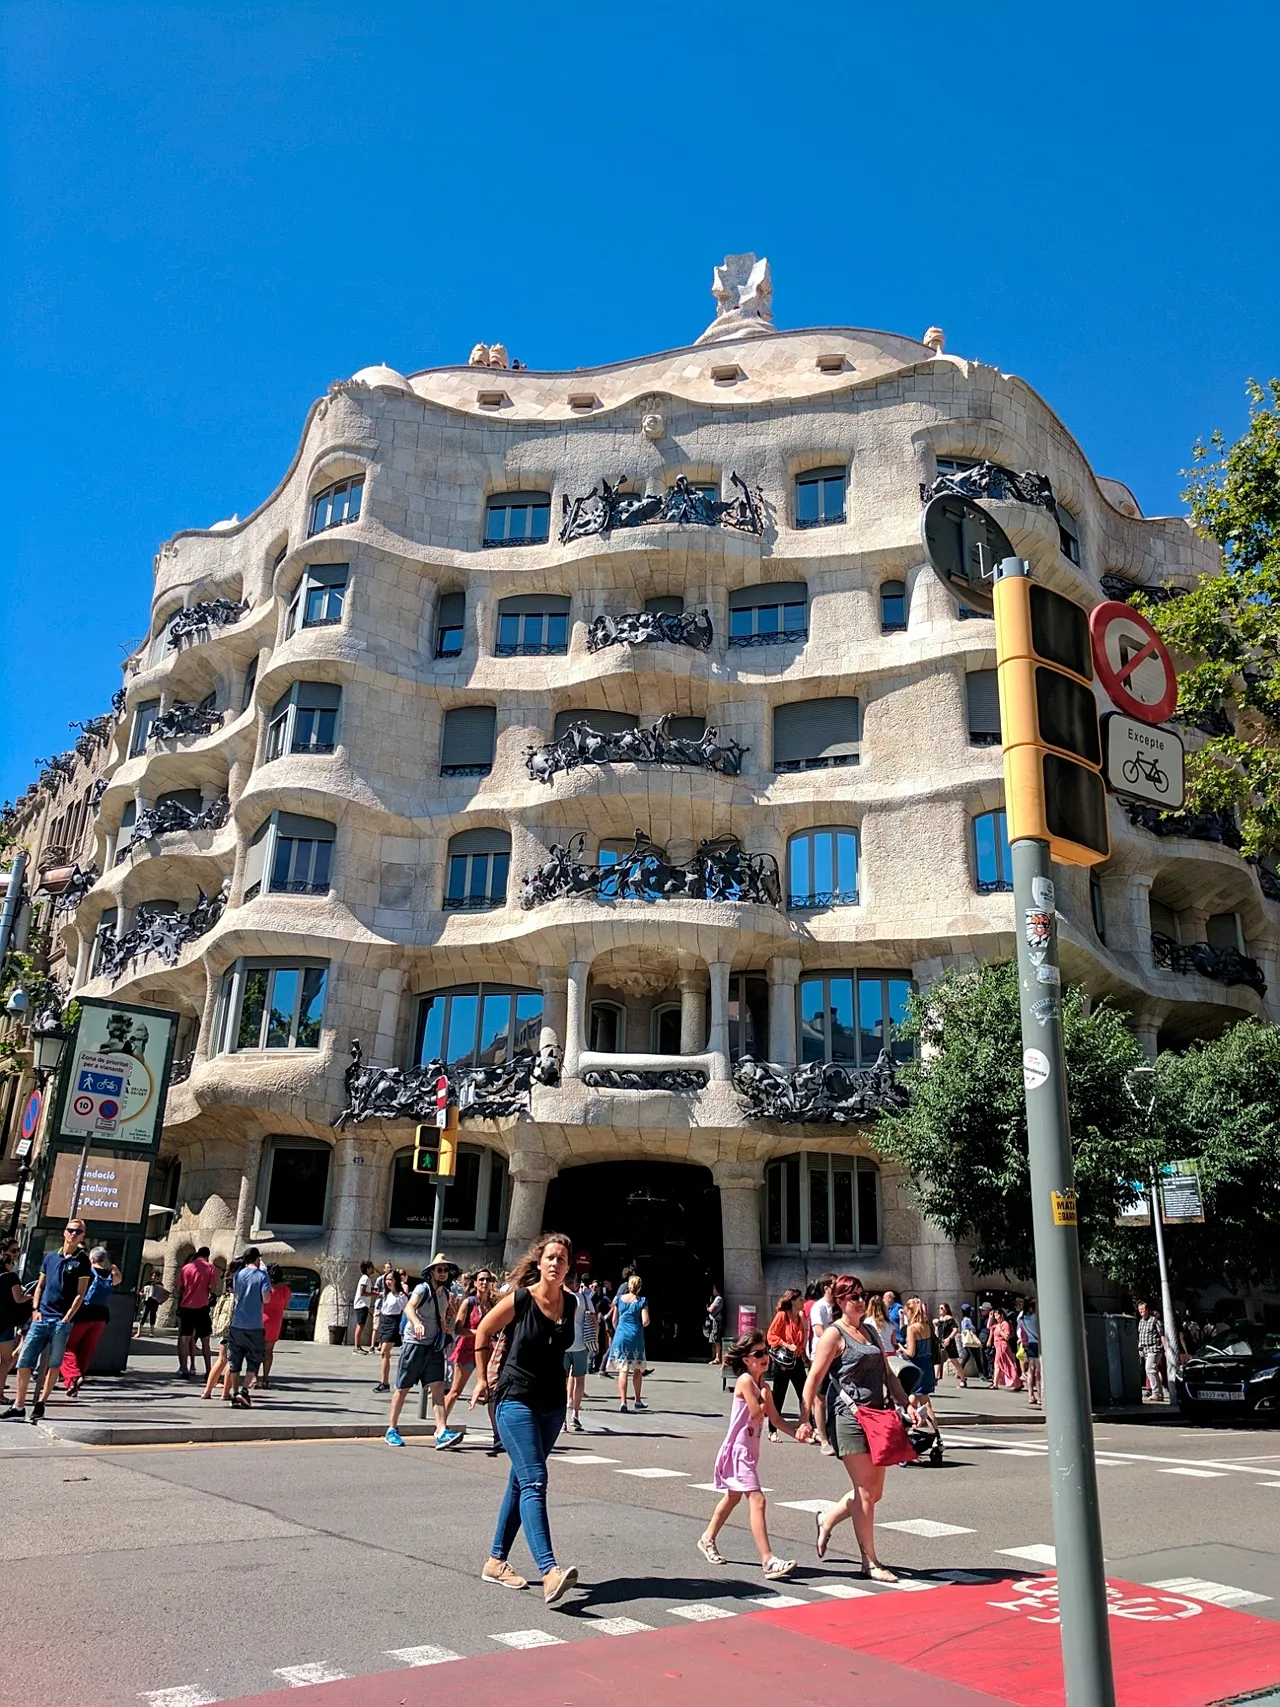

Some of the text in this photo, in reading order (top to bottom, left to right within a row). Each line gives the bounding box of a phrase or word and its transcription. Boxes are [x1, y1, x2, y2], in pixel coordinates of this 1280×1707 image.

[1128, 728, 1165, 750] Excepte
[81, 1054, 97, 1062] Zona
[105, 1060, 129, 1068] prioritat
[100, 1065, 124, 1073] vianants
[84, 1198, 118, 1208] Pedrera
